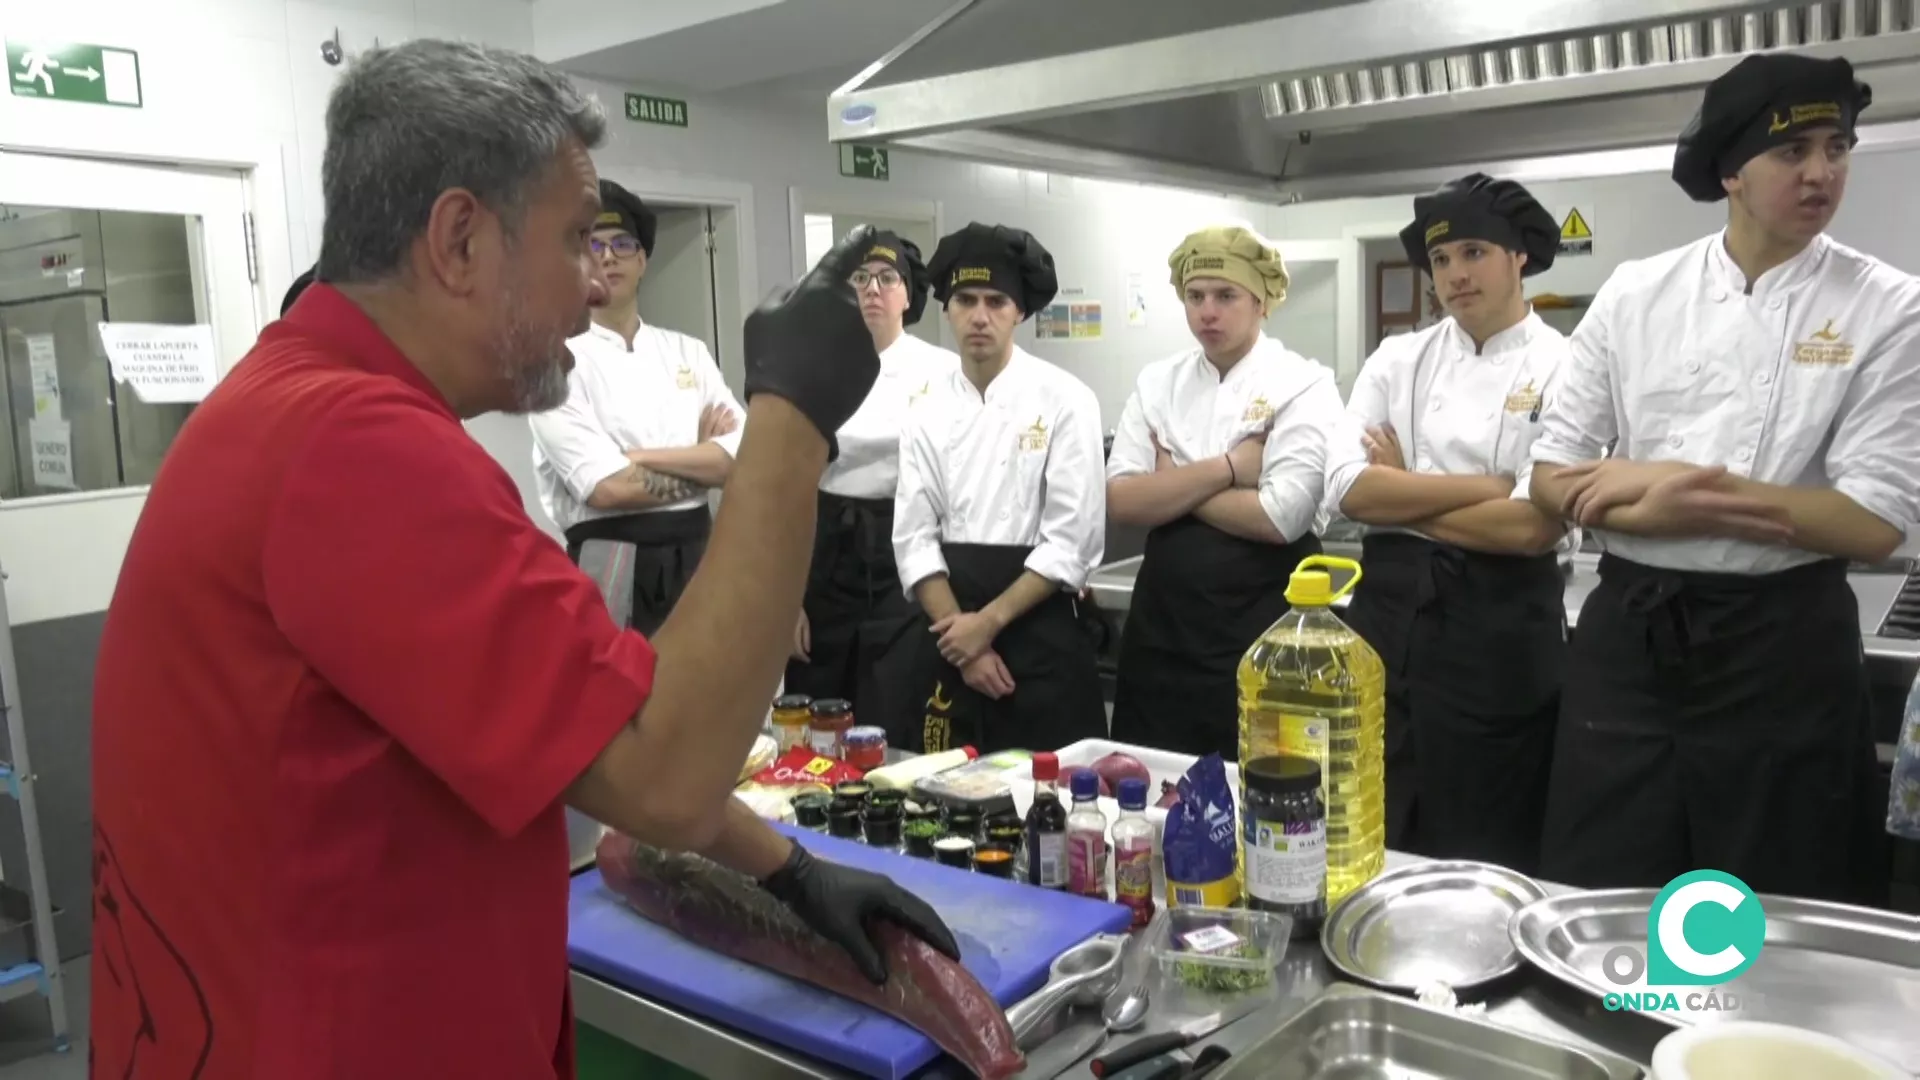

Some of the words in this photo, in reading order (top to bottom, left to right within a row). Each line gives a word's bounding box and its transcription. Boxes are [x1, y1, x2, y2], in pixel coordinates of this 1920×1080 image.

[629, 97, 684, 124] SALIDA
[173, 353, 185, 362] LA
[165, 364, 177, 373] DE
